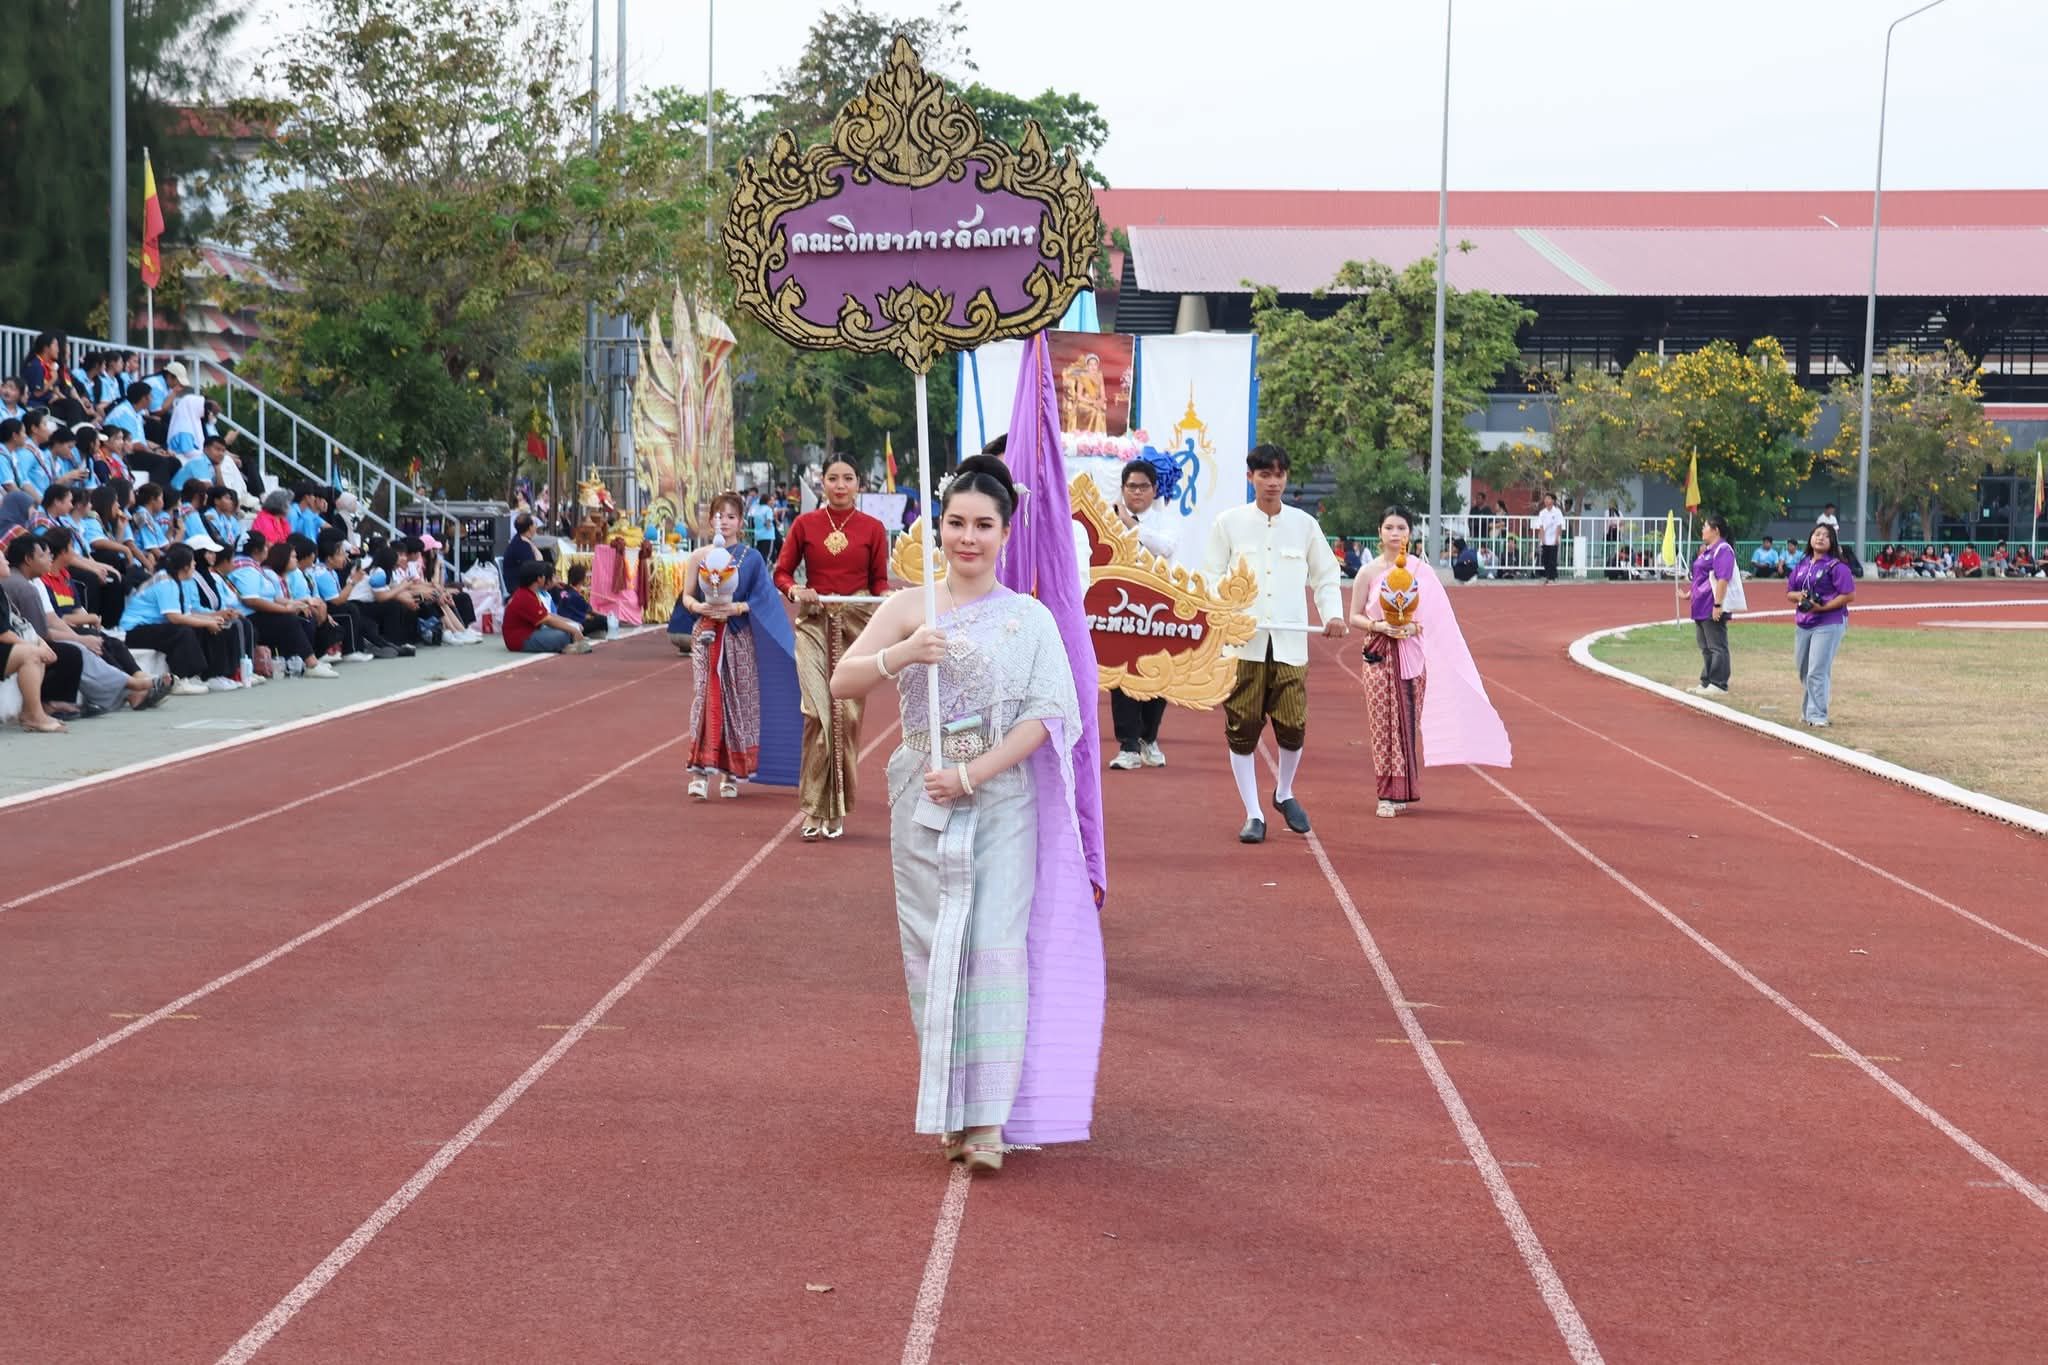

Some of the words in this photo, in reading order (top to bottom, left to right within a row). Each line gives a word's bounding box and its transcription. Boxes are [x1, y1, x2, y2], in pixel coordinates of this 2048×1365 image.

[791, 204, 1036, 253] คณะวิทยาการจัดการ
